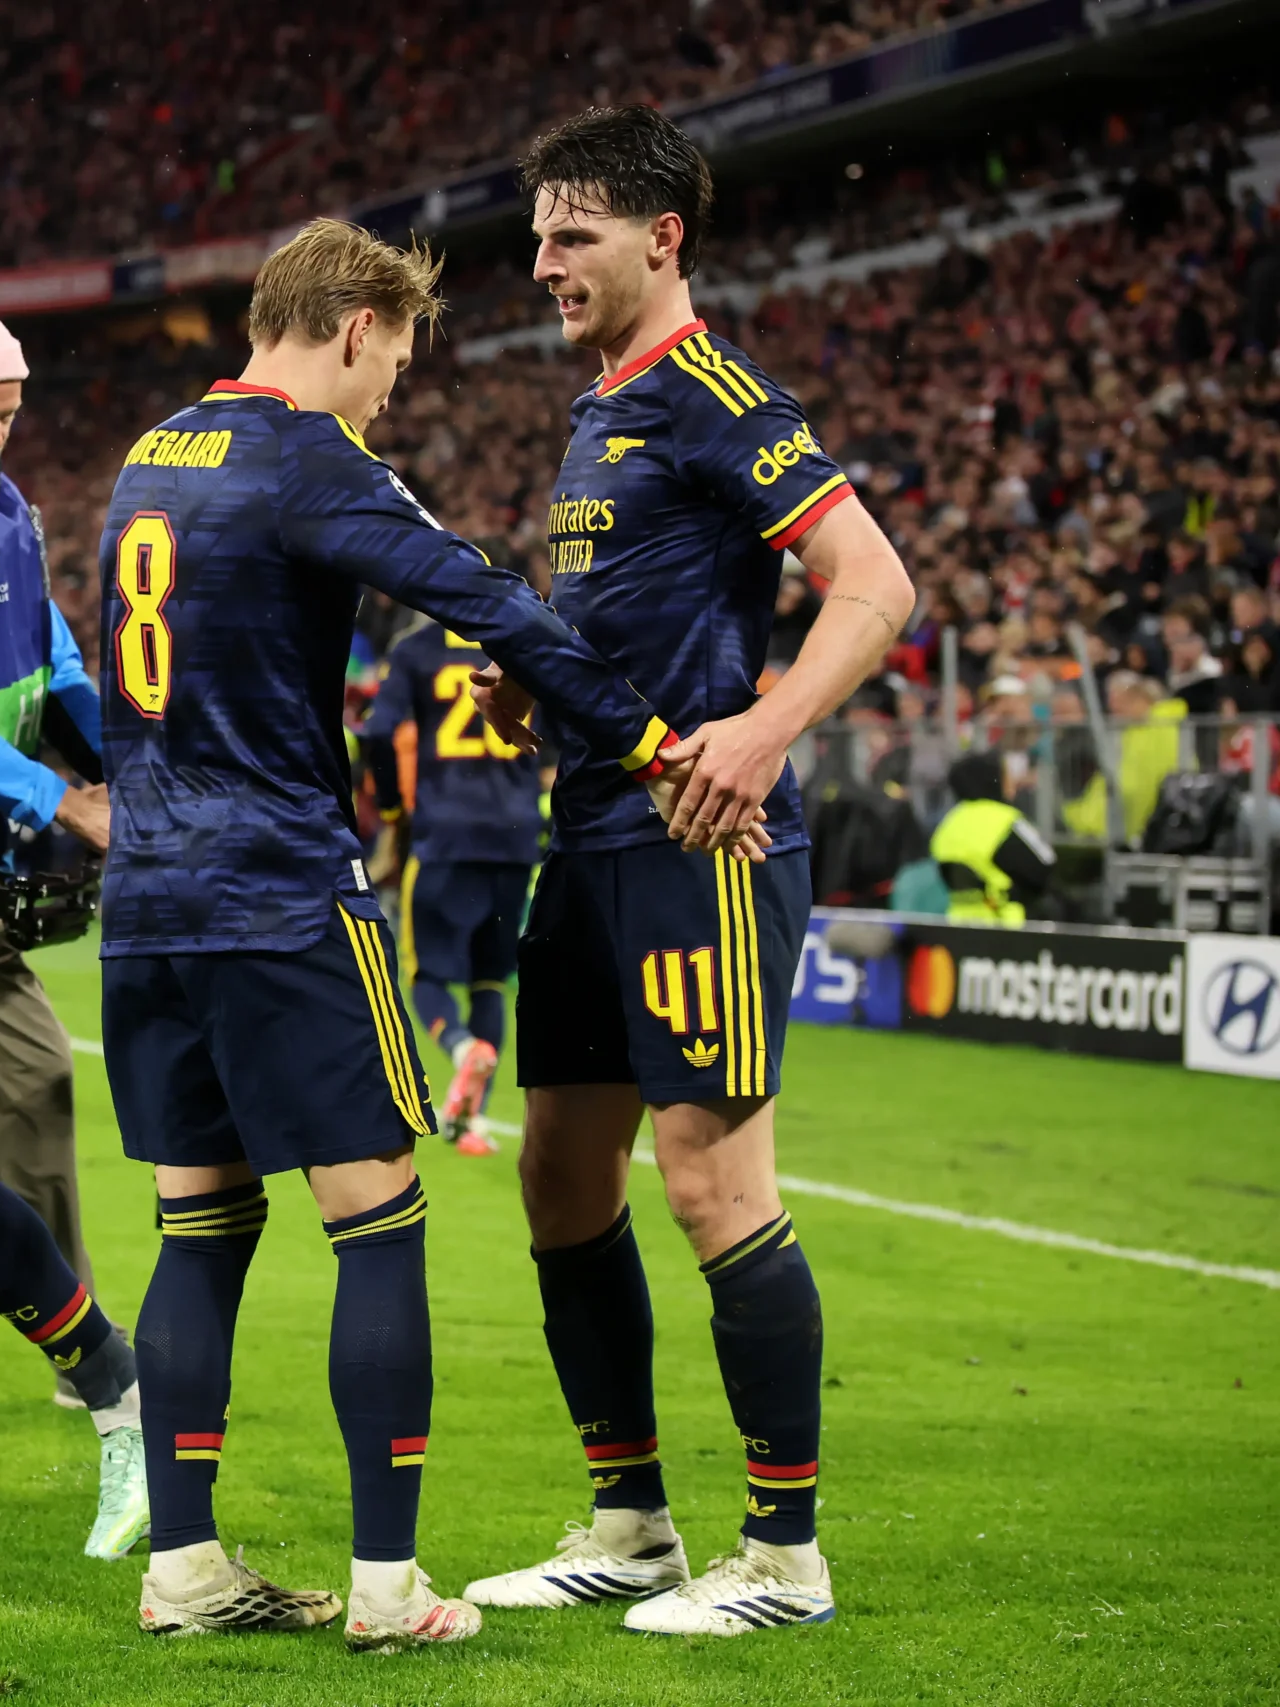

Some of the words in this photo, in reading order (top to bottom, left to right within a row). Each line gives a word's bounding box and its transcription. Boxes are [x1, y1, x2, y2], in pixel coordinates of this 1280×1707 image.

[122, 429, 233, 469] DEGAARD
[557, 539, 594, 574] BETTER
[114, 510, 177, 721] 8
[640, 946, 720, 1035] 41
[957, 947, 1183, 1036] mastercard
